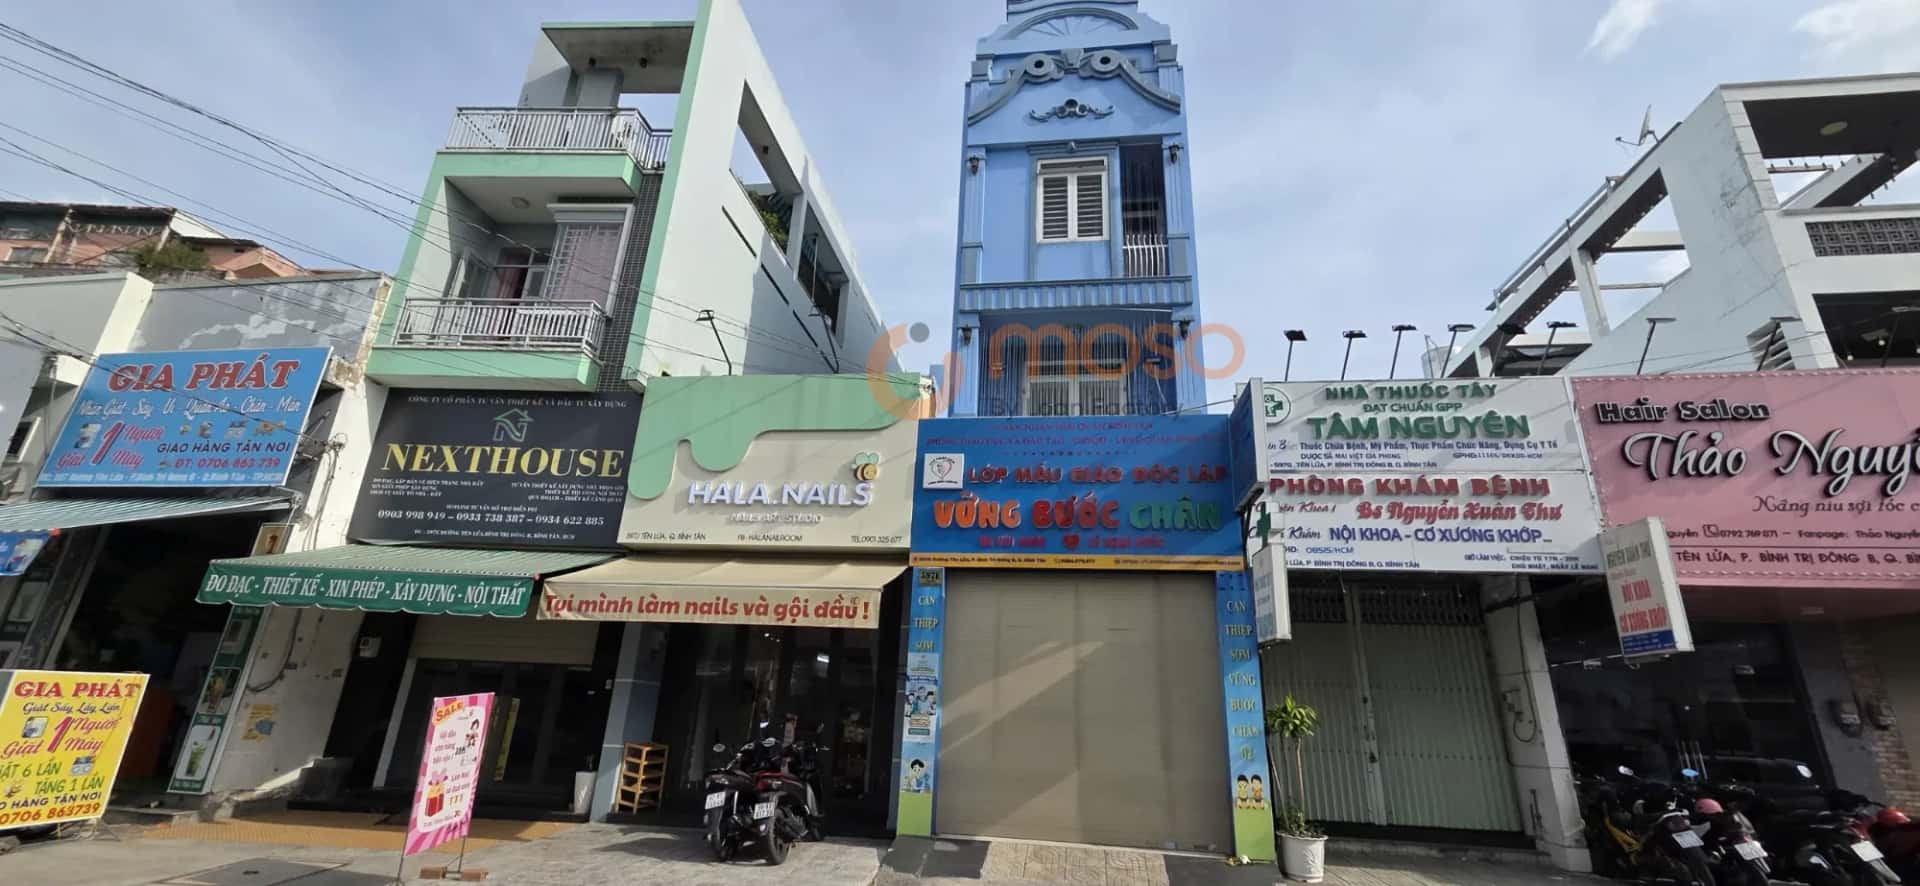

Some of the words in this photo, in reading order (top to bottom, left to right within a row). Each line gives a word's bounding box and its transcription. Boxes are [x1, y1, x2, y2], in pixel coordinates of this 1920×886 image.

[107, 362, 177, 392] GIA
[185, 353, 301, 391] PHÁT
[1325, 384, 1370, 401] NHÀ
[1373, 381, 1450, 400] THUỐC
[1455, 382, 1498, 398] TÂY
[1363, 403, 1388, 413] ĐẠT
[1435, 403, 1464, 412] GPP
[1596, 396, 1669, 422] Hair
[1677, 398, 1771, 422] Salon
[1306, 412, 1380, 440] TÂM
[92, 420, 125, 465] 1
[157, 443, 189, 454] GIAO
[191, 439, 231, 453] HÀNG
[1622, 430, 1749, 480] Thảo
[380, 443, 625, 478] NEXTHOUSE
[968, 463, 1008, 484] LỚP
[687, 480, 874, 506] HALA.NAILS
[1268, 475, 1366, 497] PHÒNG
[1375, 475, 1461, 497] KHÁM
[1469, 475, 1552, 501] BỆNH
[933, 490, 1022, 530] VỮNG
[1031, 490, 1121, 531] BƯỚC
[1129, 495, 1222, 531] CHÂN
[1357, 501, 1384, 520] Bs
[1386, 499, 1460, 525] Nguyễn
[1520, 502, 1564, 521] Thư
[1847, 499, 1873, 515] sợi
[1329, 524, 1357, 545] NỘI
[1360, 527, 1403, 543] KHOA
[1413, 526, 1437, 543] CƠ
[1438, 525, 1496, 544] XƯƠNG
[1675, 550, 1700, 562] TÊN
[1759, 550, 1791, 563] BÌNH
[1794, 551, 1815, 565] TRỊ
[1818, 551, 1860, 564] ĐÔNG
[205, 574, 229, 593] ĐO
[228, 574, 256, 600] ĐẠC
[261, 571, 300, 597] THIẾT
[325, 578, 351, 599] XIN
[350, 575, 385, 600] PHÉP
[389, 577, 418, 601] XÂY
[417, 582, 458, 608] DỰNG
[462, 581, 492, 610] NỘI
[491, 582, 528, 606] THẤT
[545, 594, 574, 617] Tụi
[577, 592, 633, 614] mình
[637, 593, 680, 614] làm
[684, 596, 738, 617] nails
[743, 598, 769, 617] và
[774, 597, 811, 623] gội
[814, 593, 859, 619] đầu
[15, 681, 62, 697] GIA
[72, 679, 142, 698] PHÁT
[22, 764, 32, 778] 6
[11, 794, 49, 809] HÀNG
